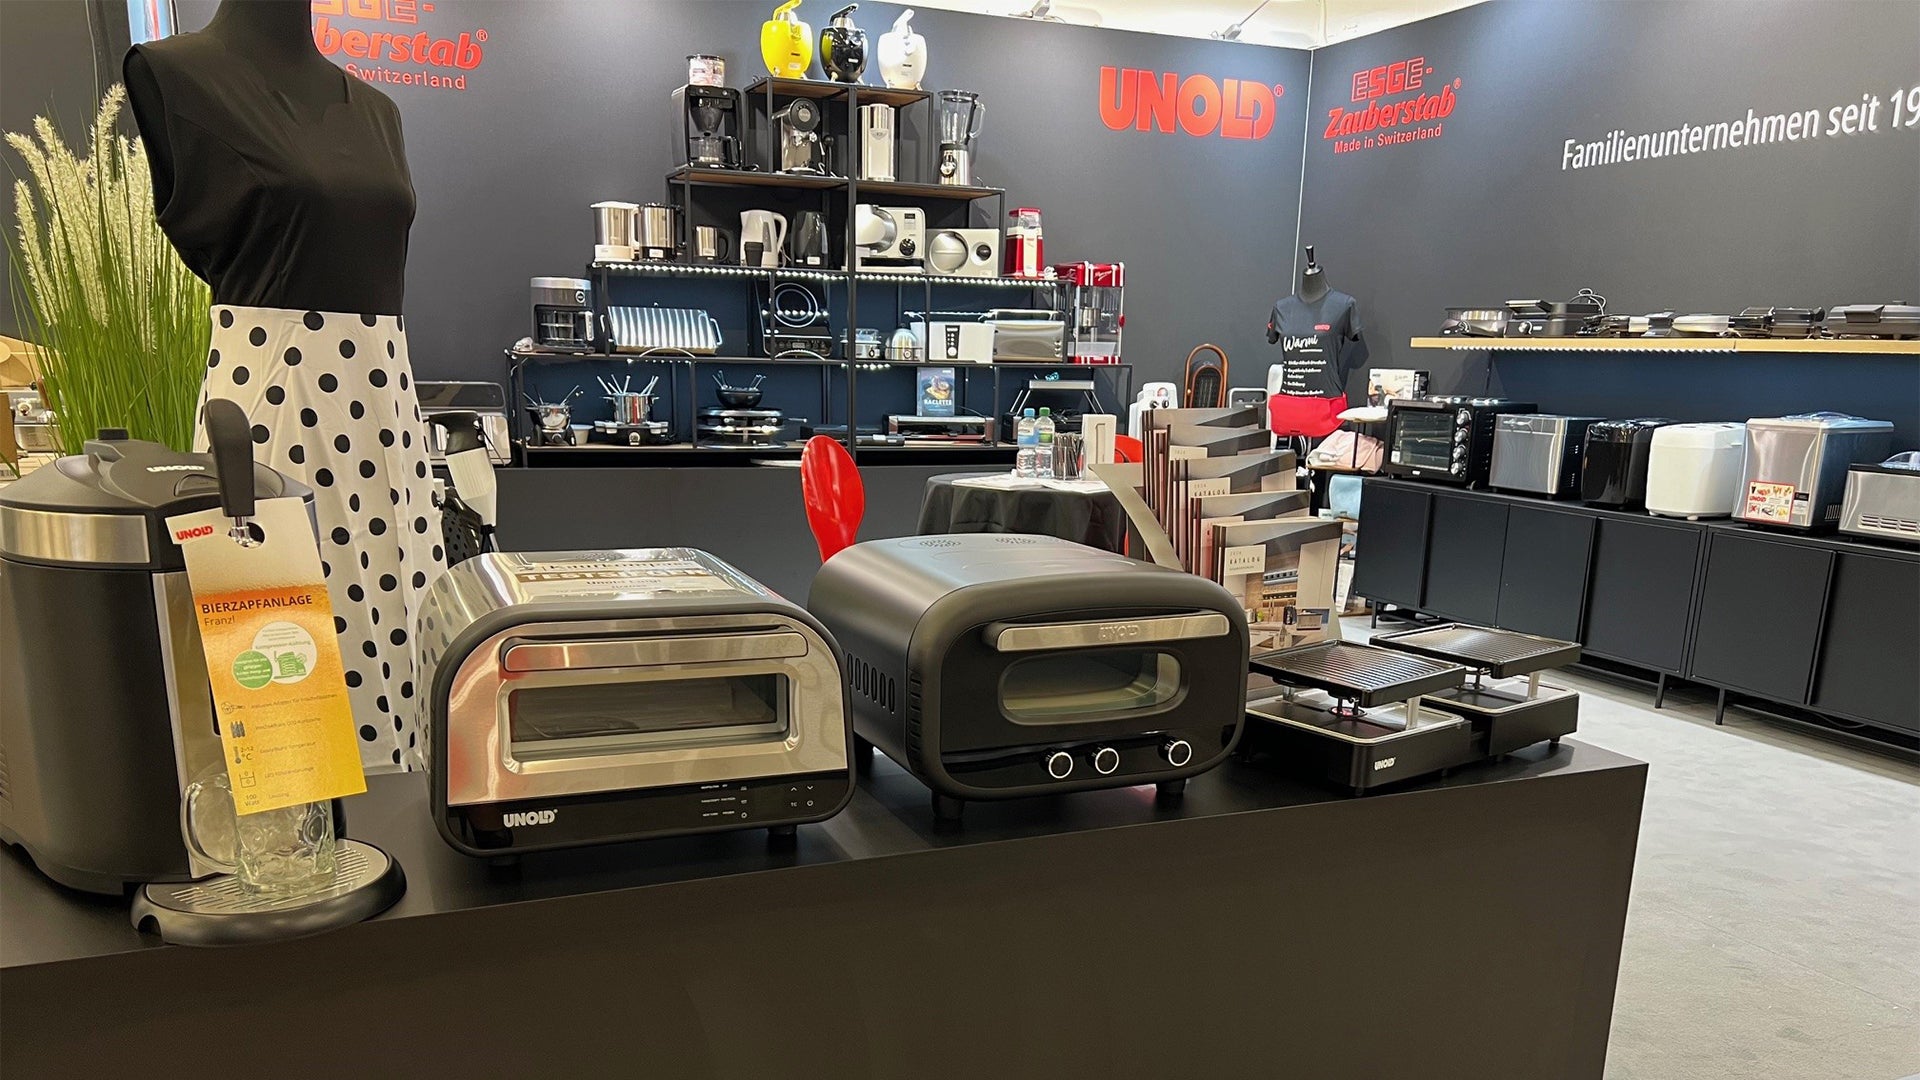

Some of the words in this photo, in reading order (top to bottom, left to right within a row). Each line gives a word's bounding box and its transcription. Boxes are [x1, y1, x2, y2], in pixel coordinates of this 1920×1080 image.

[314, 16, 484, 70] berstab
[1100, 66, 1277, 140] UNOLD
[1323, 84, 1456, 139] Zauberstab
[1334, 141, 1361, 154] Made
[1364, 135, 1374, 149] in
[1377, 123, 1442, 147] Switzerland
[1561, 108, 1820, 170] Familienunternehmen
[1825, 93, 1880, 135] seit
[176, 525, 214, 541] UNOLD
[201, 594, 313, 614] BIERZAPFANLAGE
[204, 615, 235, 627] Franzl
[503, 809, 558, 828] UNOLD
